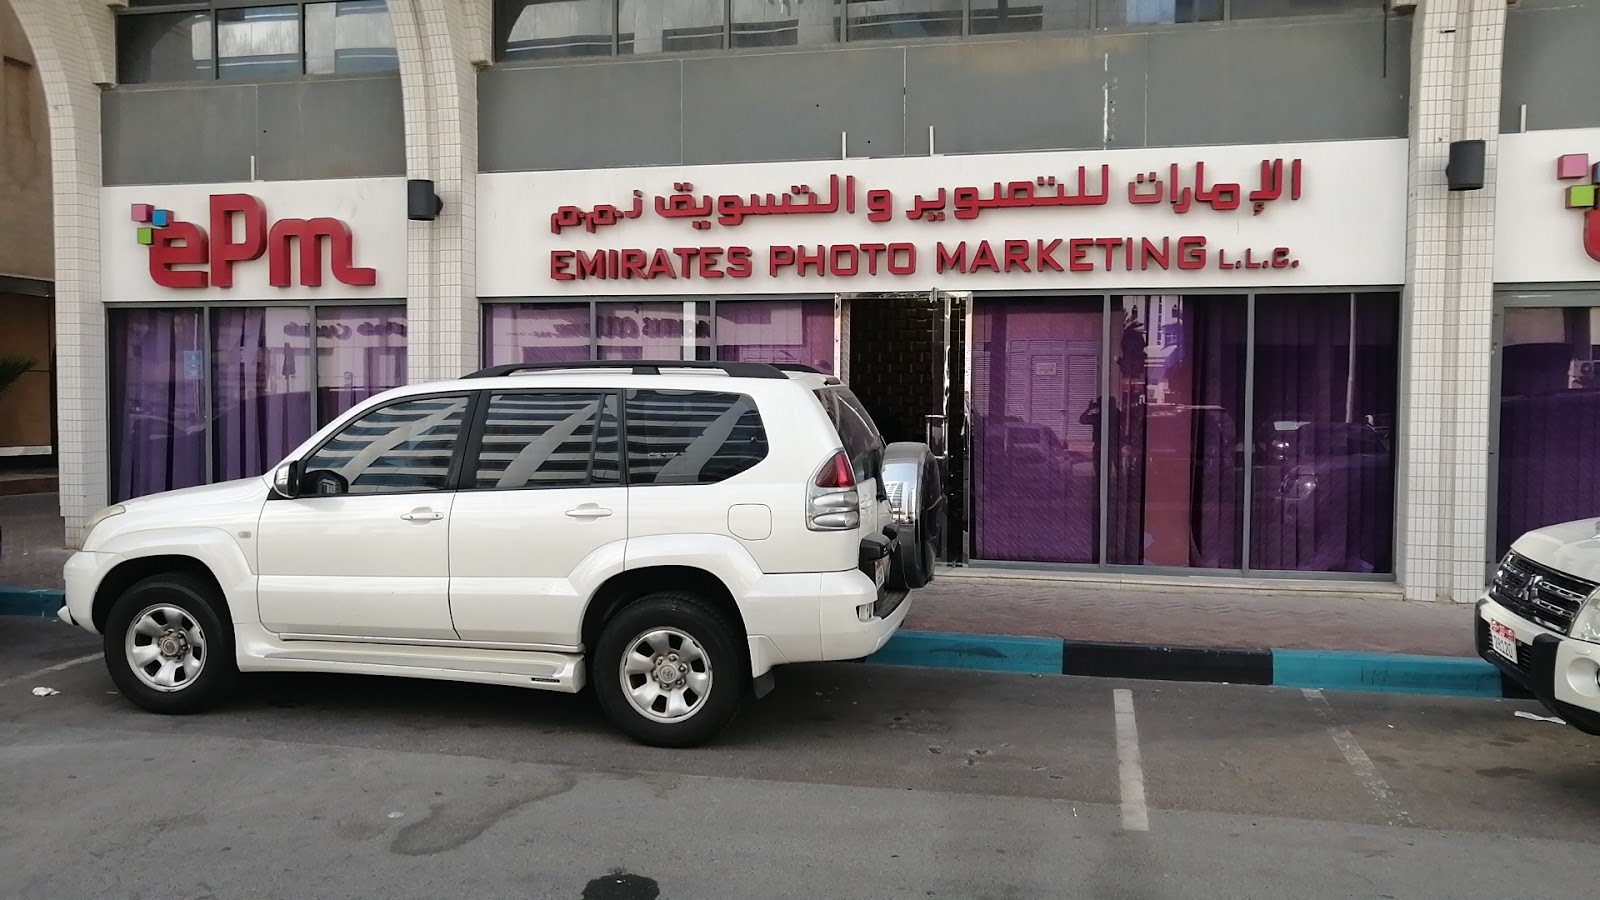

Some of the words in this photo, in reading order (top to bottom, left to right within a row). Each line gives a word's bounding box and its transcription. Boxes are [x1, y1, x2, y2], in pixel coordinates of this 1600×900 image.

[906, 164, 1110, 221] للتصوير
[1128, 159, 1302, 215] الإمارات
[550, 246, 752, 280] EMIRATES
[769, 242, 917, 277] PHOTO
[936, 236, 1207, 274] MARKETING
[1219, 247, 1299, 270] L.L.C.
